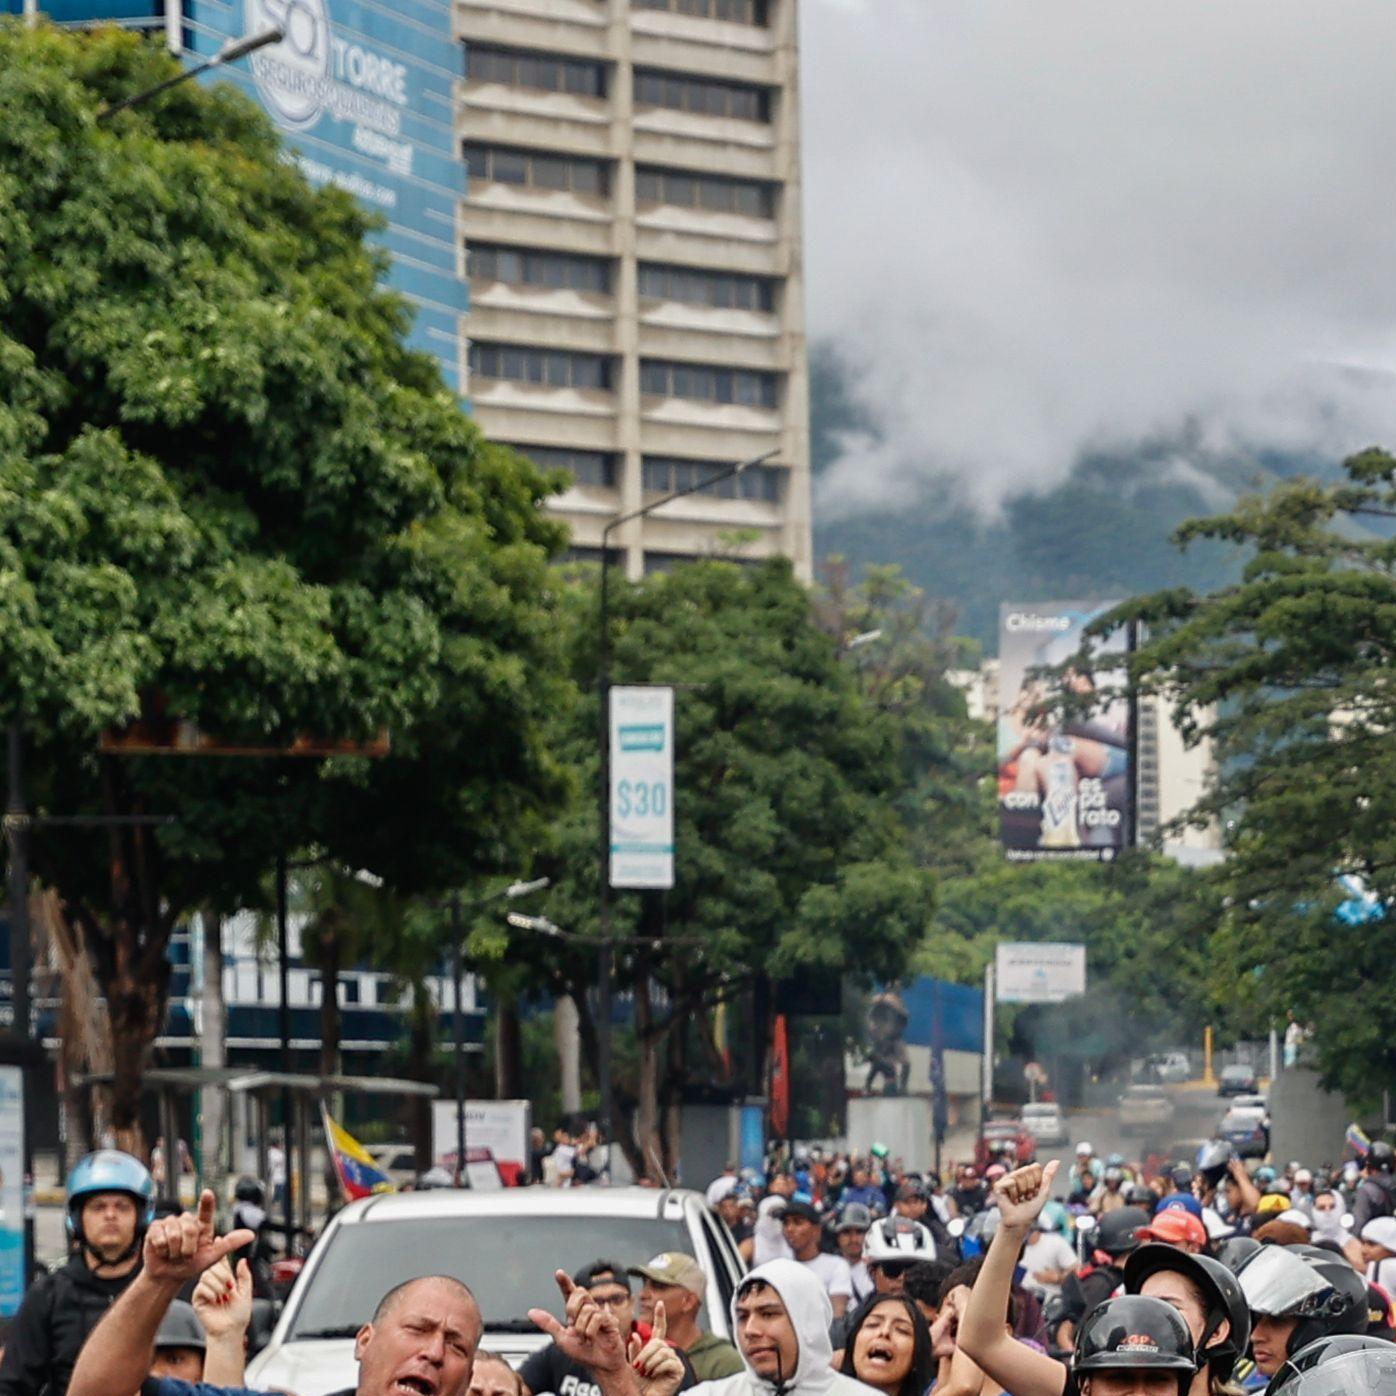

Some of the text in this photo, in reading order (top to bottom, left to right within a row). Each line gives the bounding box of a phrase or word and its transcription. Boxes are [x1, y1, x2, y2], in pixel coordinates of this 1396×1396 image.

[332, 37, 408, 104] TORRE
[1005, 612, 1071, 632] Chisme
[617, 777, 666, 818] $30
[1004, 792, 1040, 809] con
